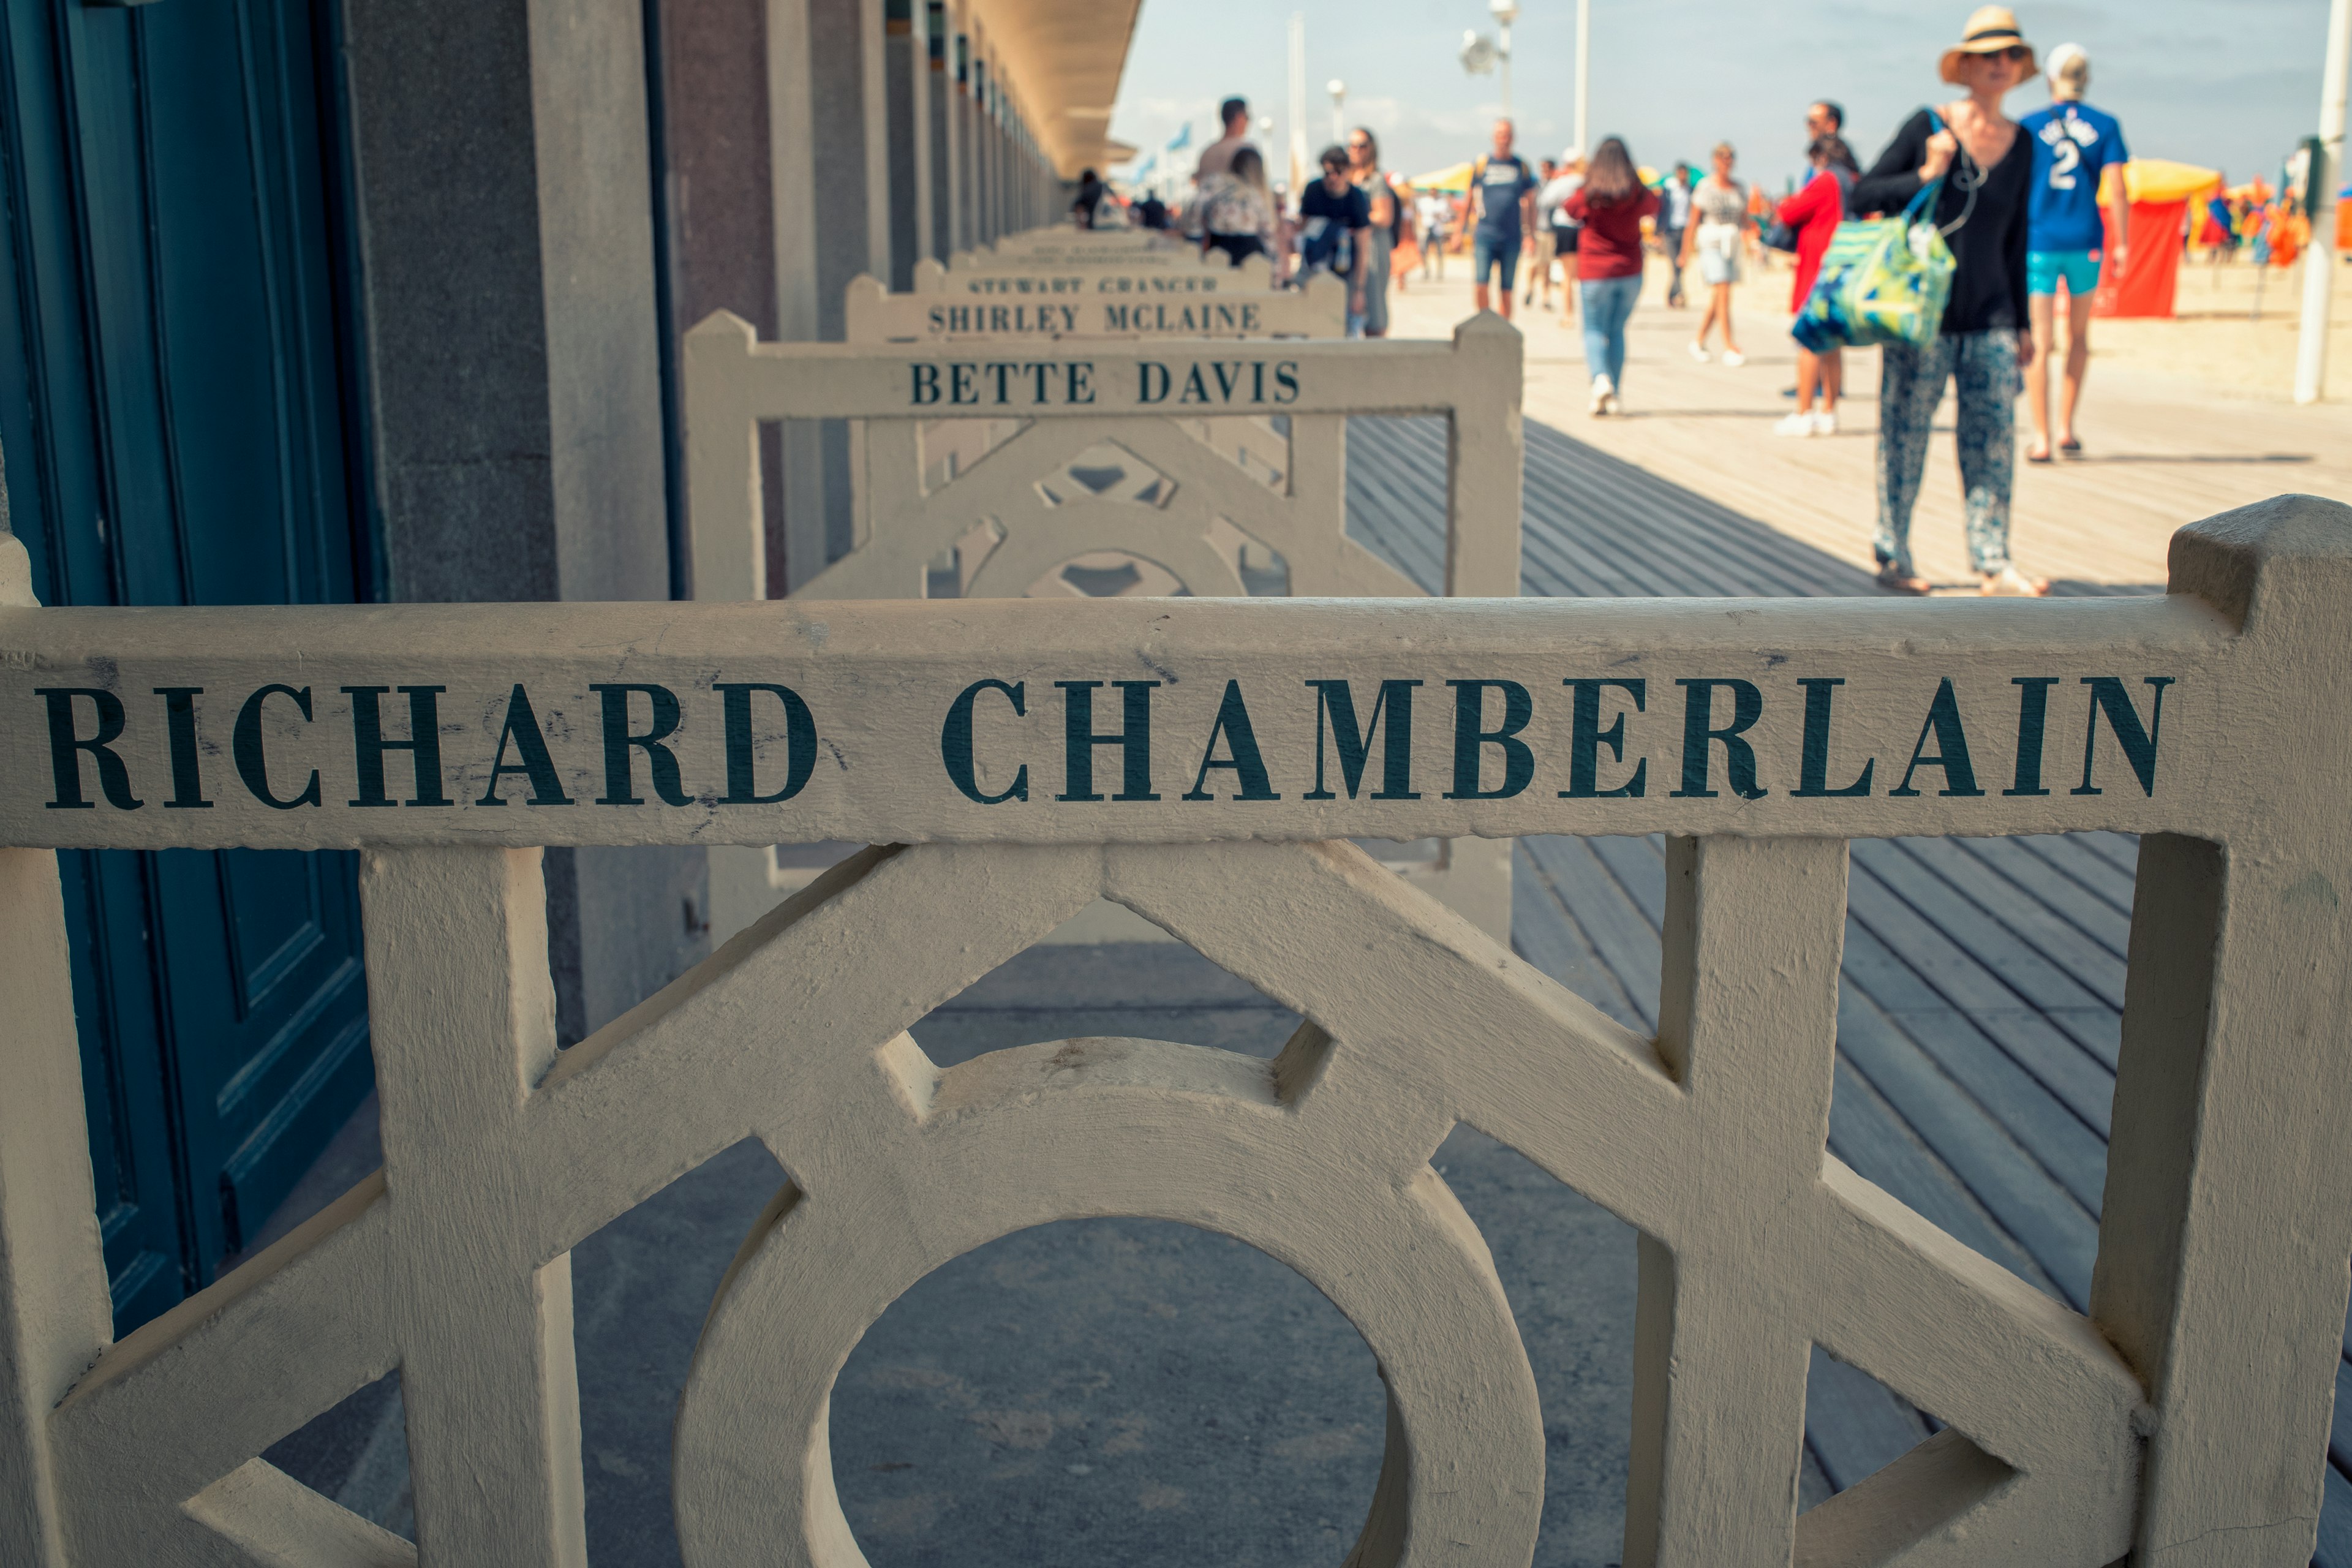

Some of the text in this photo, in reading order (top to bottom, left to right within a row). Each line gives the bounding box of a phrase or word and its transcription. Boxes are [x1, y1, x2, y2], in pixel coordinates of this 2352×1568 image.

[2049, 137, 2079, 190] 2
[967, 276, 1084, 293] STEWART
[928, 303, 1261, 333] SHIRLEY MCLAINE
[910, 361, 1300, 405] BETTE DAVIS
[34, 676, 2176, 810] RICHARD CHAMBERLAIN
